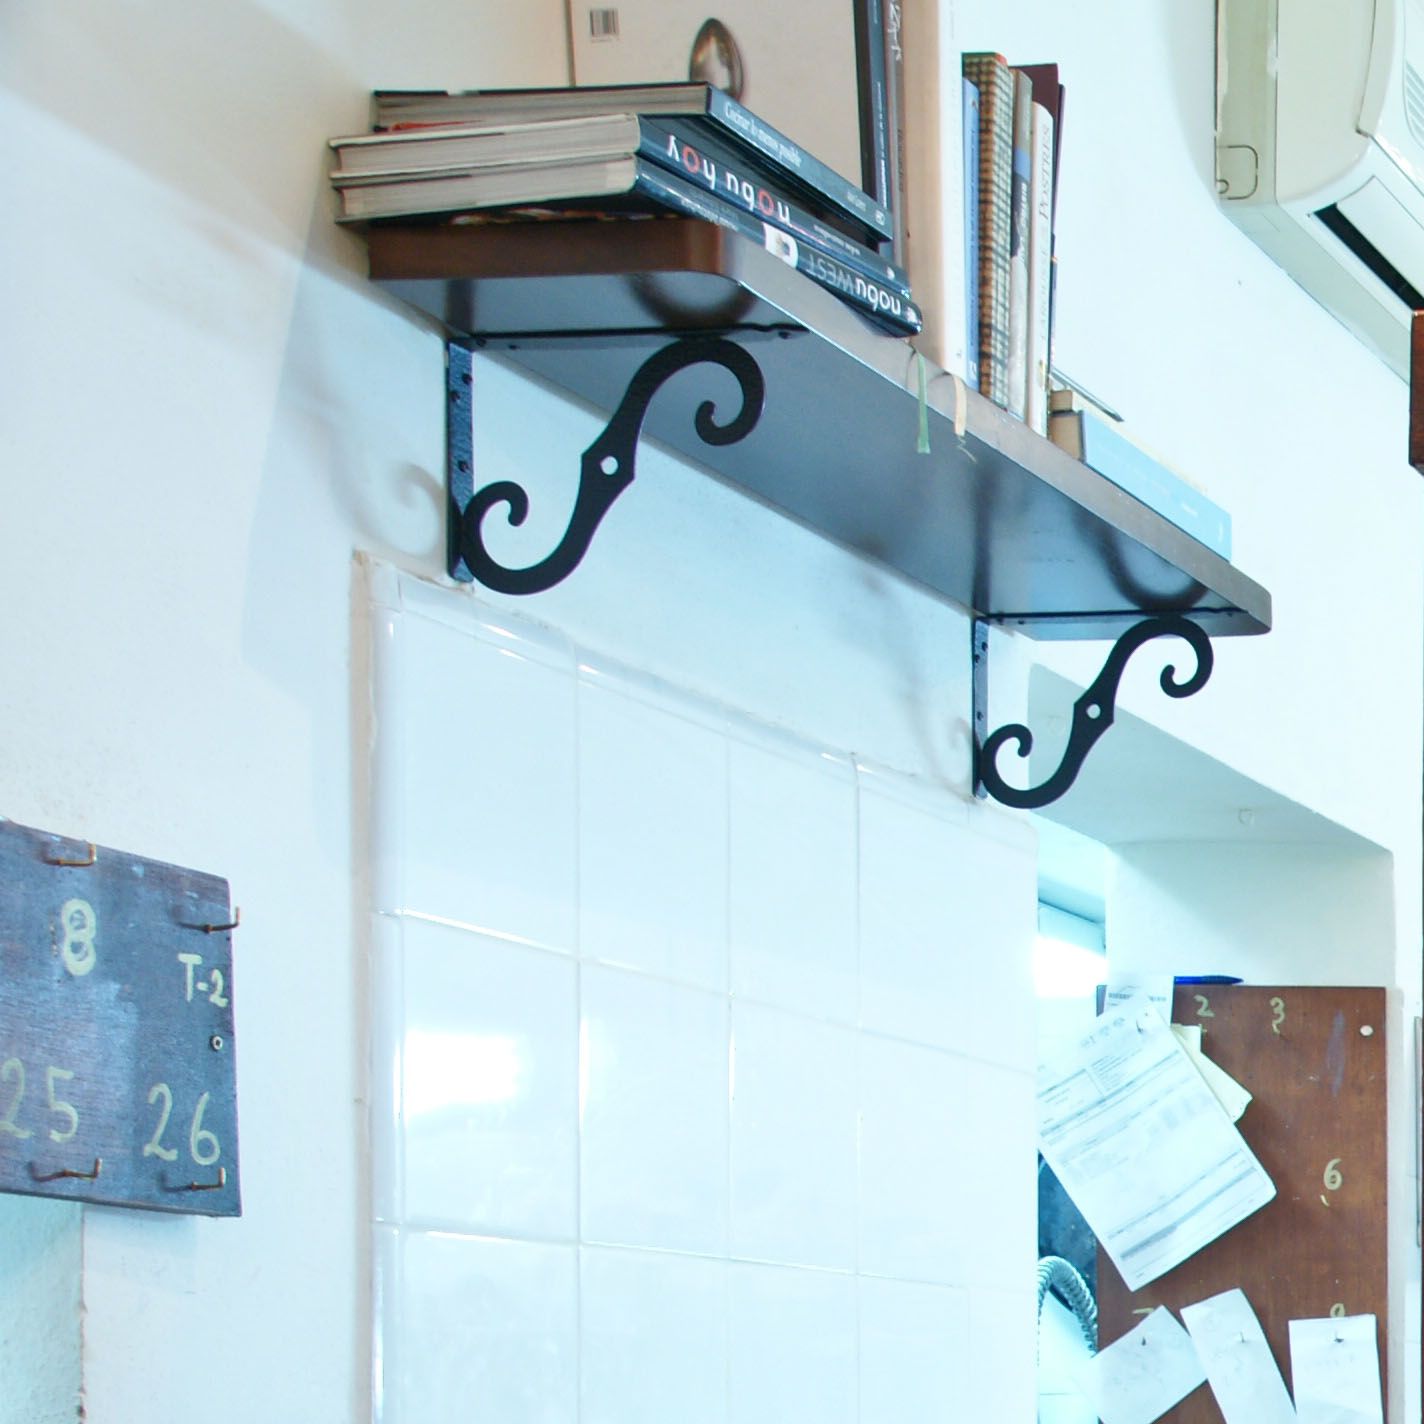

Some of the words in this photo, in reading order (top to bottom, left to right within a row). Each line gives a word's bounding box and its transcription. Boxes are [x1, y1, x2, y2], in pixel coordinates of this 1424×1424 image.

[667, 134, 716, 191] hoy
[726, 171, 792, 229] nobu
[61, 898, 97, 976] 8
[177, 952, 229, 1008] T-2
[1193, 994, 1216, 1018] 2
[1269, 996, 1286, 1026] 3
[0, 1056, 80, 1143] 25
[143, 1083, 222, 1166] 26
[1323, 1157, 1343, 1191] 6
